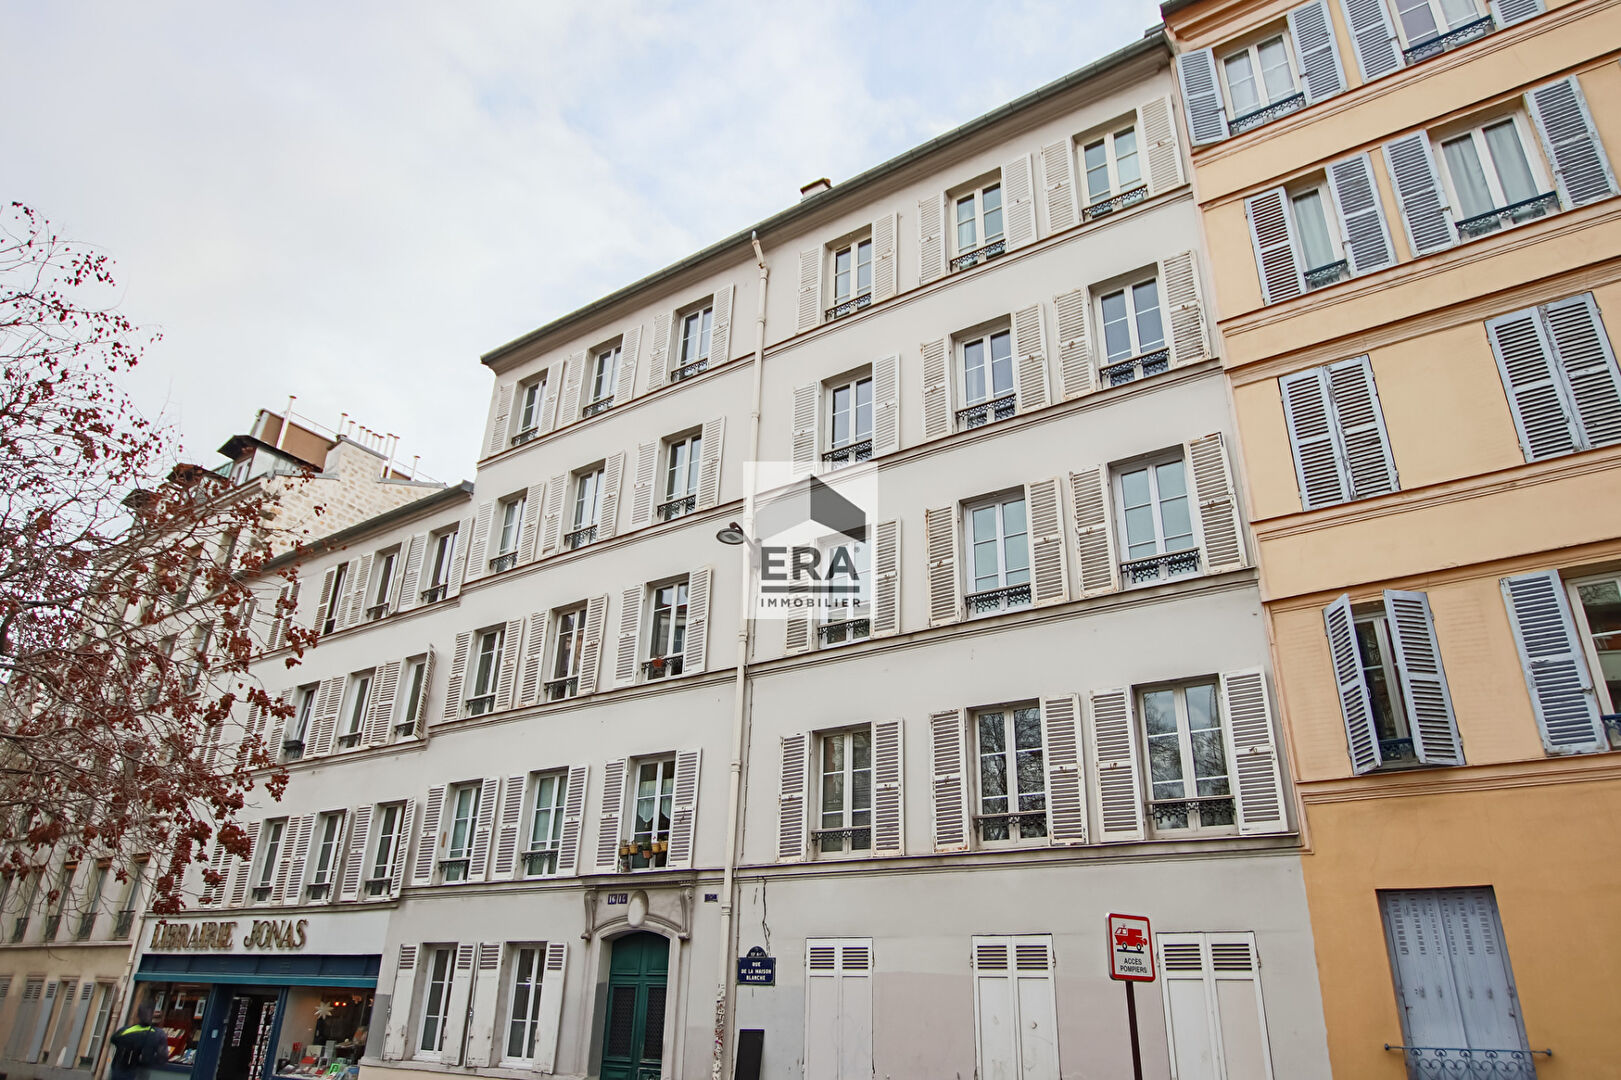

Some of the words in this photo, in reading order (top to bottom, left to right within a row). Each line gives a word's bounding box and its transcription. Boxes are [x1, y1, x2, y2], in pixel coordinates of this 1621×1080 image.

[150, 921, 238, 949] LIBRAIRIE
[243, 919, 309, 949] JONAS
[1119, 964, 1147, 973] POMPIERS
